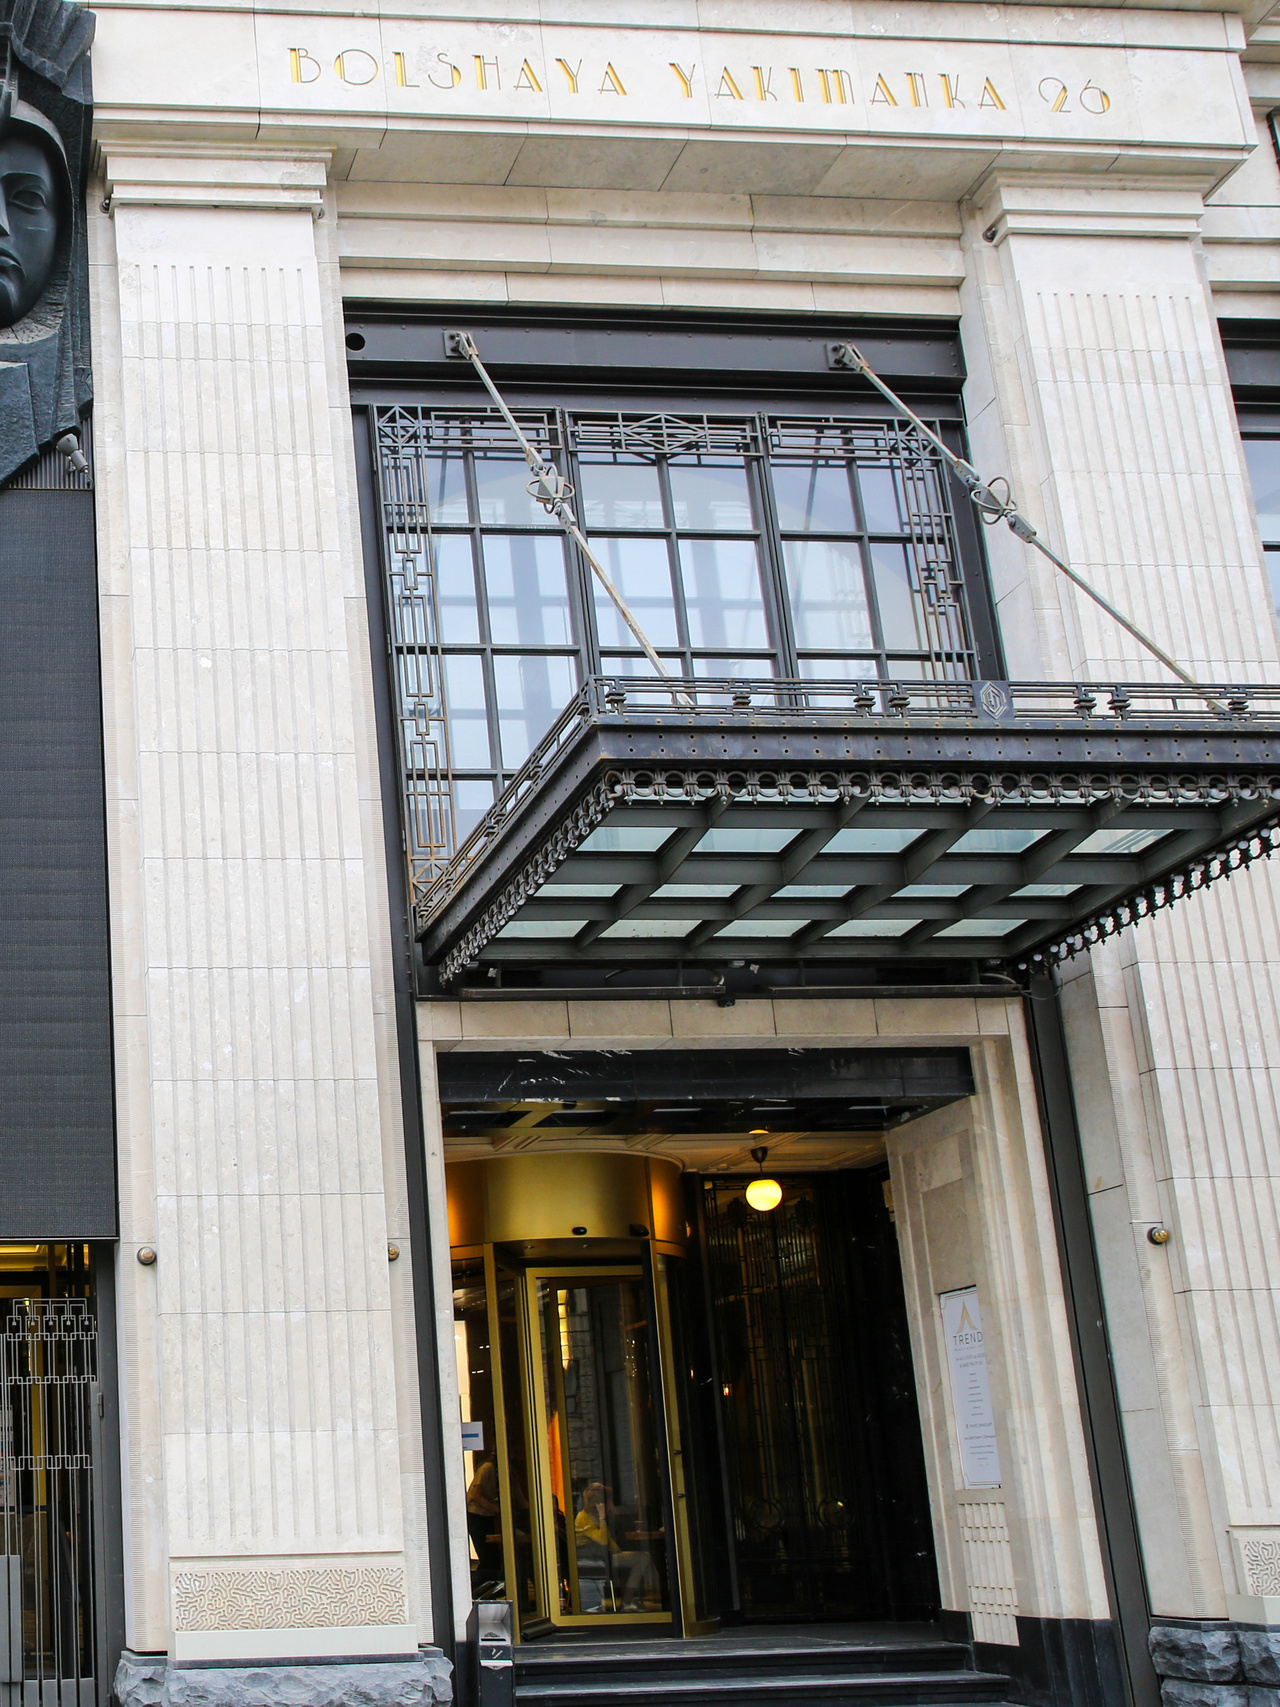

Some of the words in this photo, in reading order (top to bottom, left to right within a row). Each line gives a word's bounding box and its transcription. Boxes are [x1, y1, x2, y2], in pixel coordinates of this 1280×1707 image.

[286, 47, 628, 96] BOLSHAYA
[668, 61, 1007, 111] YAKIMANKA
[1037, 76, 1111, 115] 26
[953, 1331, 984, 1346] TREND
